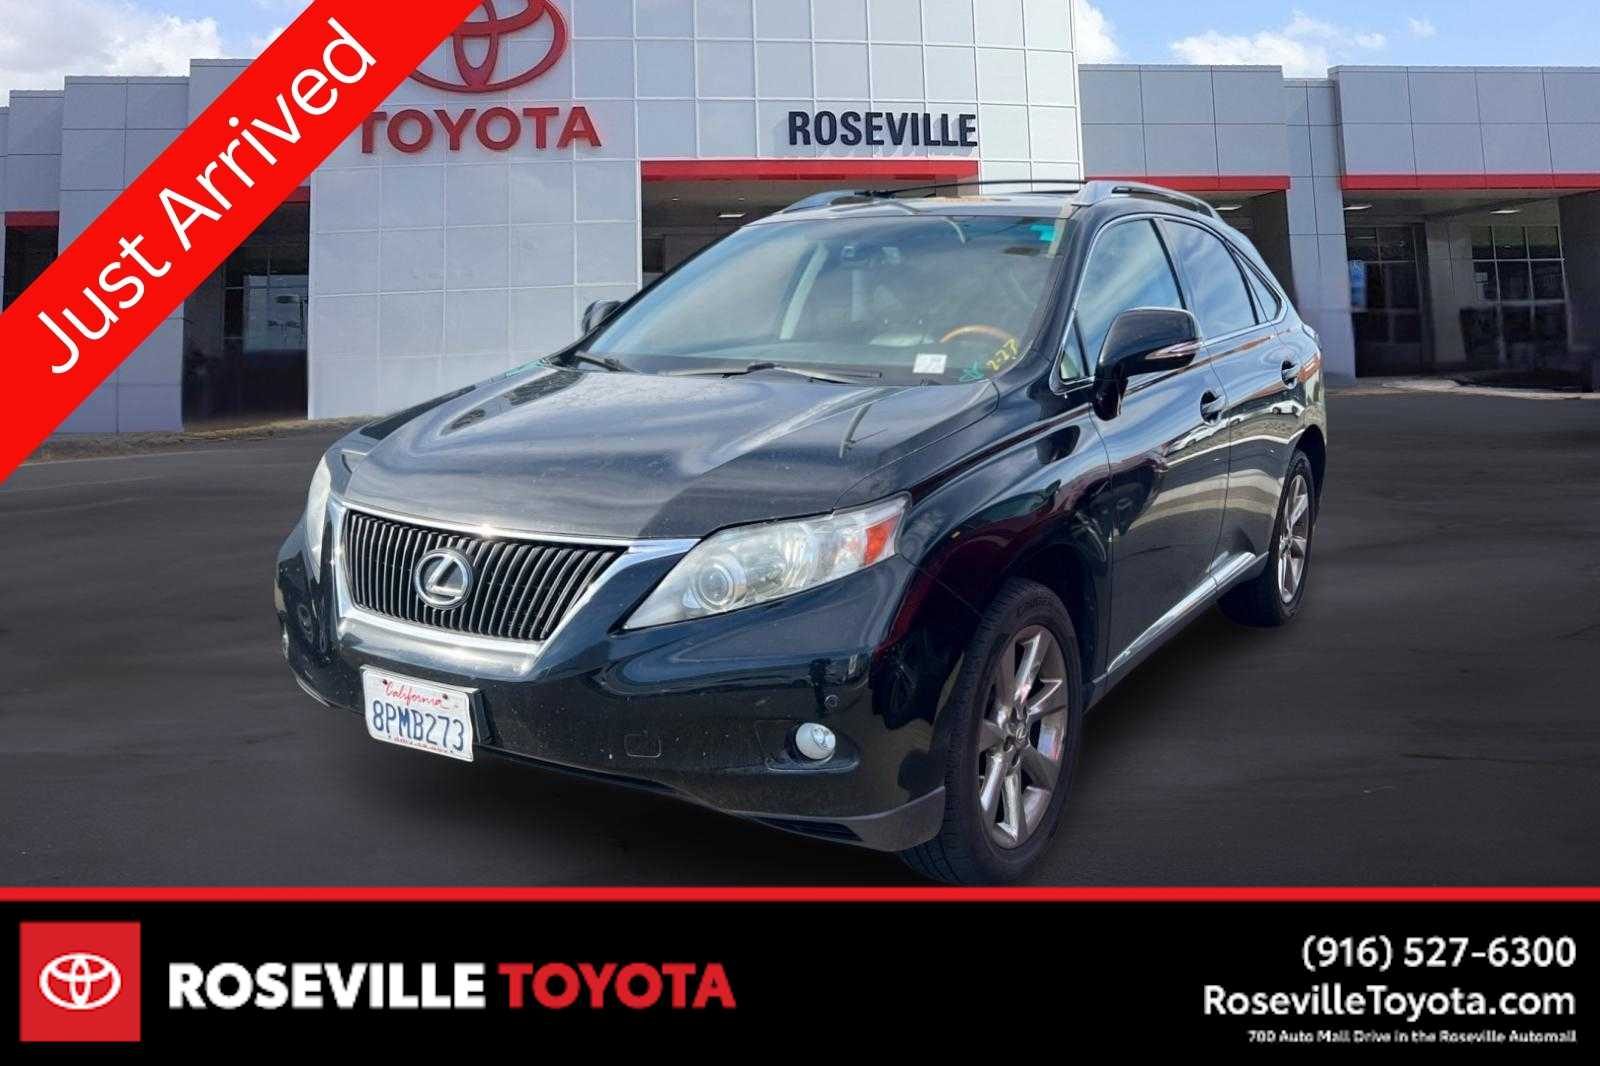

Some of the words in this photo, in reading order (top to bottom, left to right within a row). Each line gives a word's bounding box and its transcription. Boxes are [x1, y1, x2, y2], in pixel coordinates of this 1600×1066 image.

[360, 106, 602, 154] TOYOTA
[788, 111, 978, 147] ROSEVILLE
[384, 680, 446, 707] California
[372, 700, 465, 752] 8PMB273
